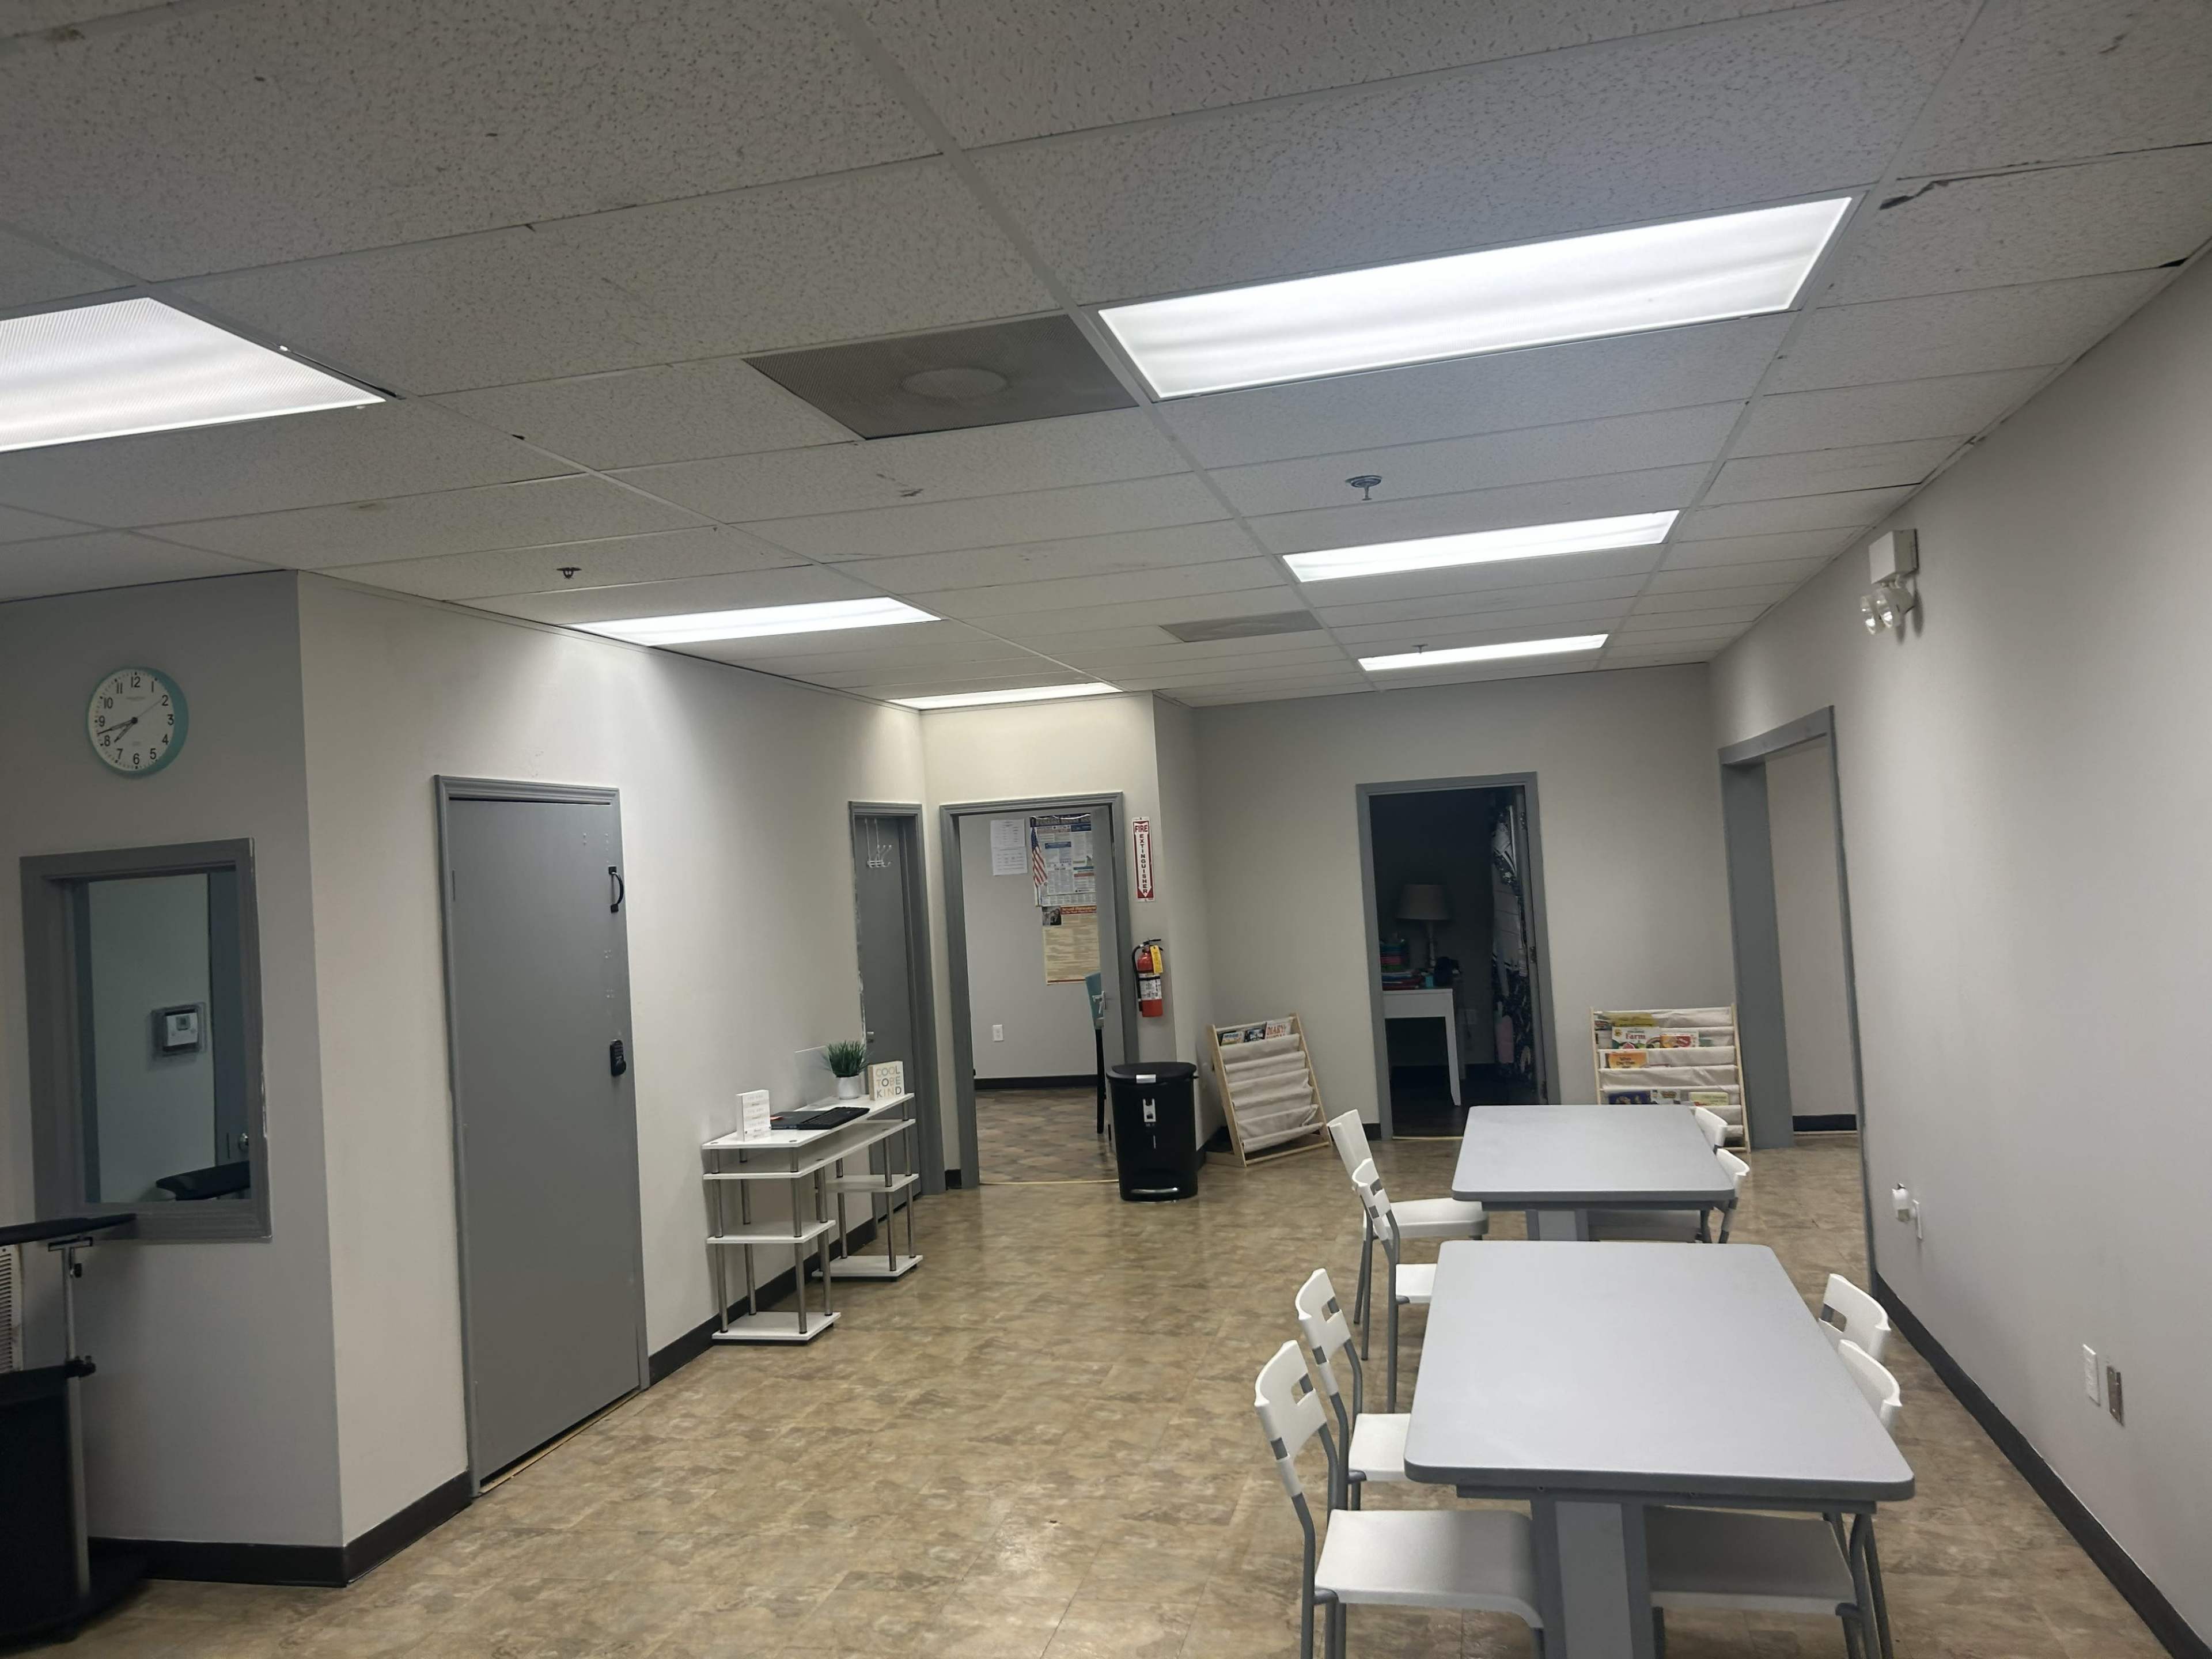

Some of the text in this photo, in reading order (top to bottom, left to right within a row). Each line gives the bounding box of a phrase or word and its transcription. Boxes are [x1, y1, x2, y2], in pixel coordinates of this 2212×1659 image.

[131, 676, 141, 688] 12
[151, 681, 154, 693] 1
[116, 683, 123, 694] 11
[103, 697, 113, 709] 10
[161, 695, 169, 706] 2
[99, 715, 105, 727] 9
[167, 714, 175, 726] 3
[104, 735, 111, 747] 8
[161, 734, 169, 745] 4
[116, 748, 123, 760] 7
[132, 753, 140, 765] 6
[150, 748, 157, 760] 5
[1135, 825, 1148, 833] FIRE
[1139, 834, 1148, 894] EXTINGUISHER
[876, 1066, 901, 1077] COOL
[877, 1086, 902, 1098] KIND
